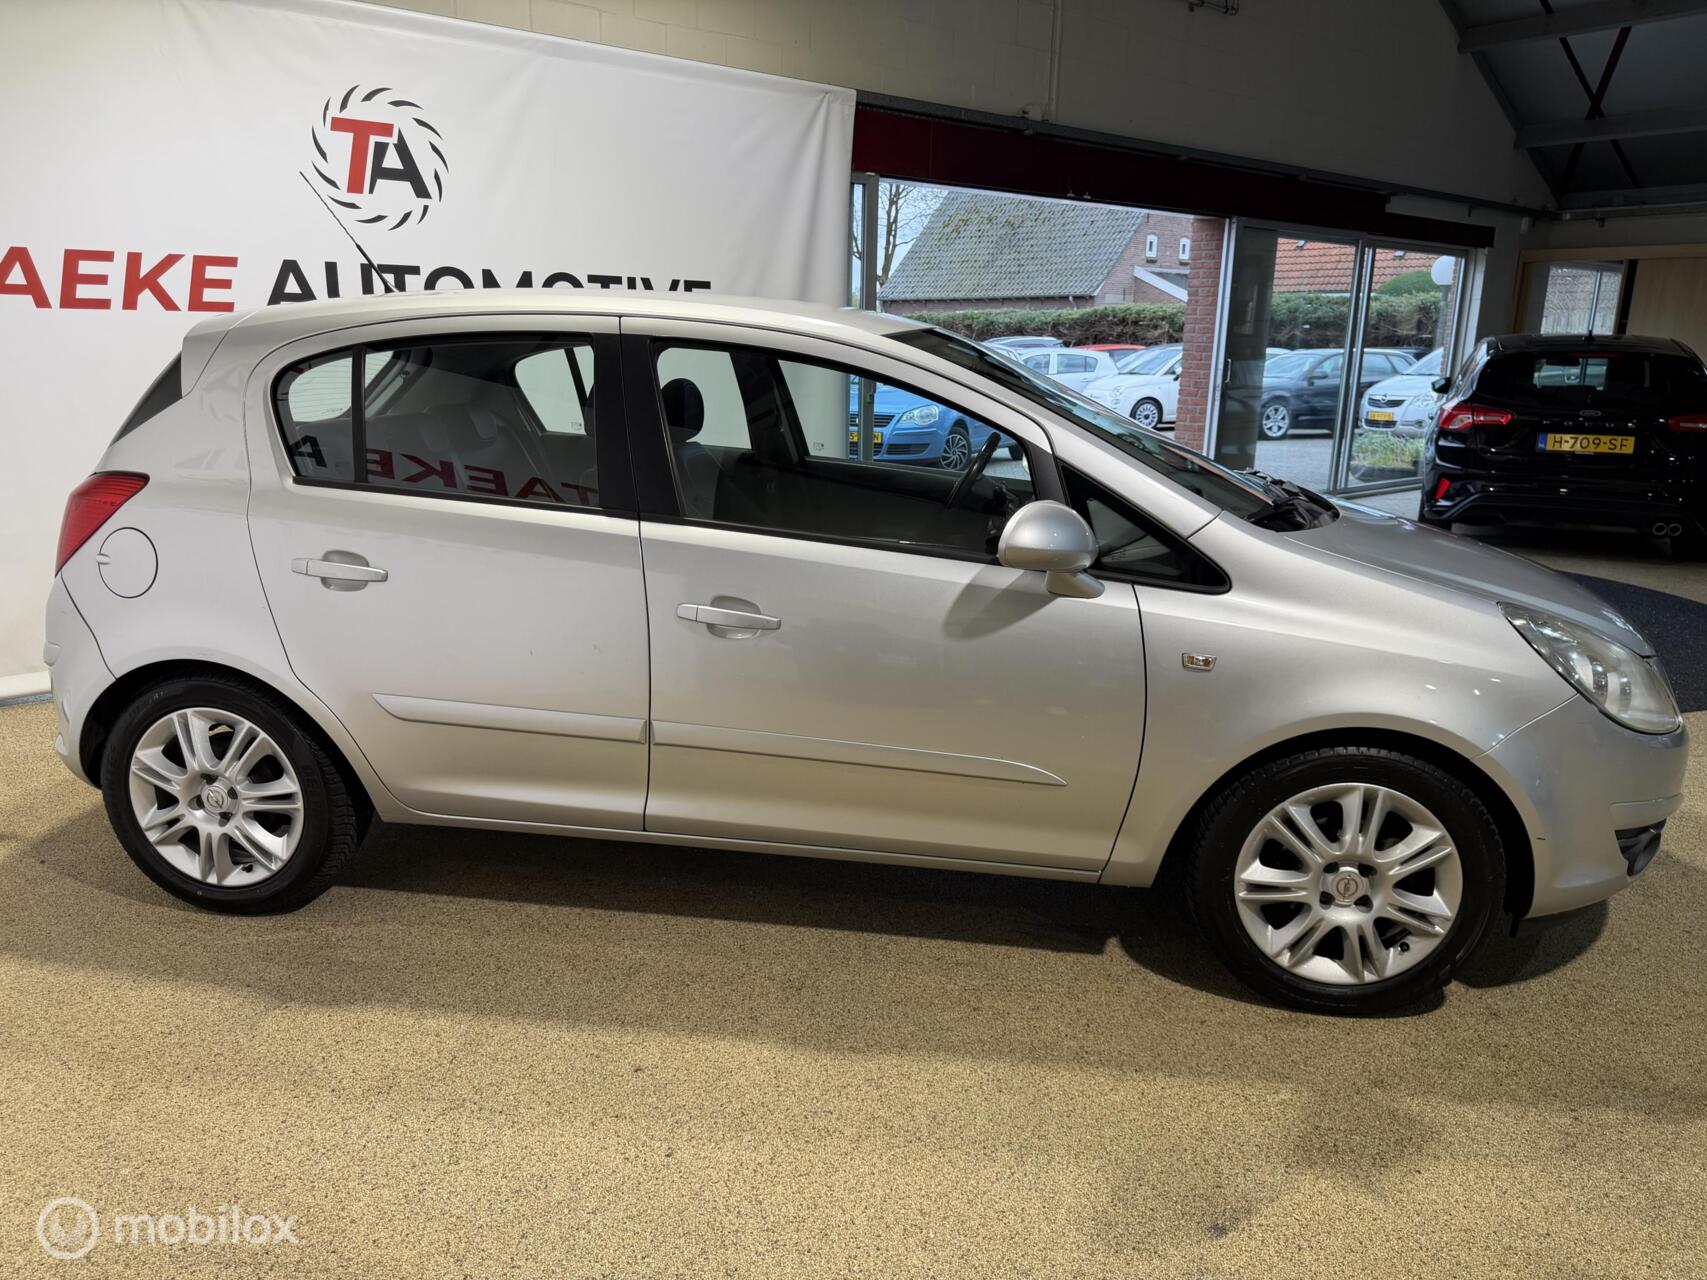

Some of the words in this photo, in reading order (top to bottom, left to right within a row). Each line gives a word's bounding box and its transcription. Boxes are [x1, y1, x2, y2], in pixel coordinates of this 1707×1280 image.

[330, 116, 432, 200] TA
[0, 246, 239, 312] AEKE
[1552, 435, 1630, 451] H-709-SF
